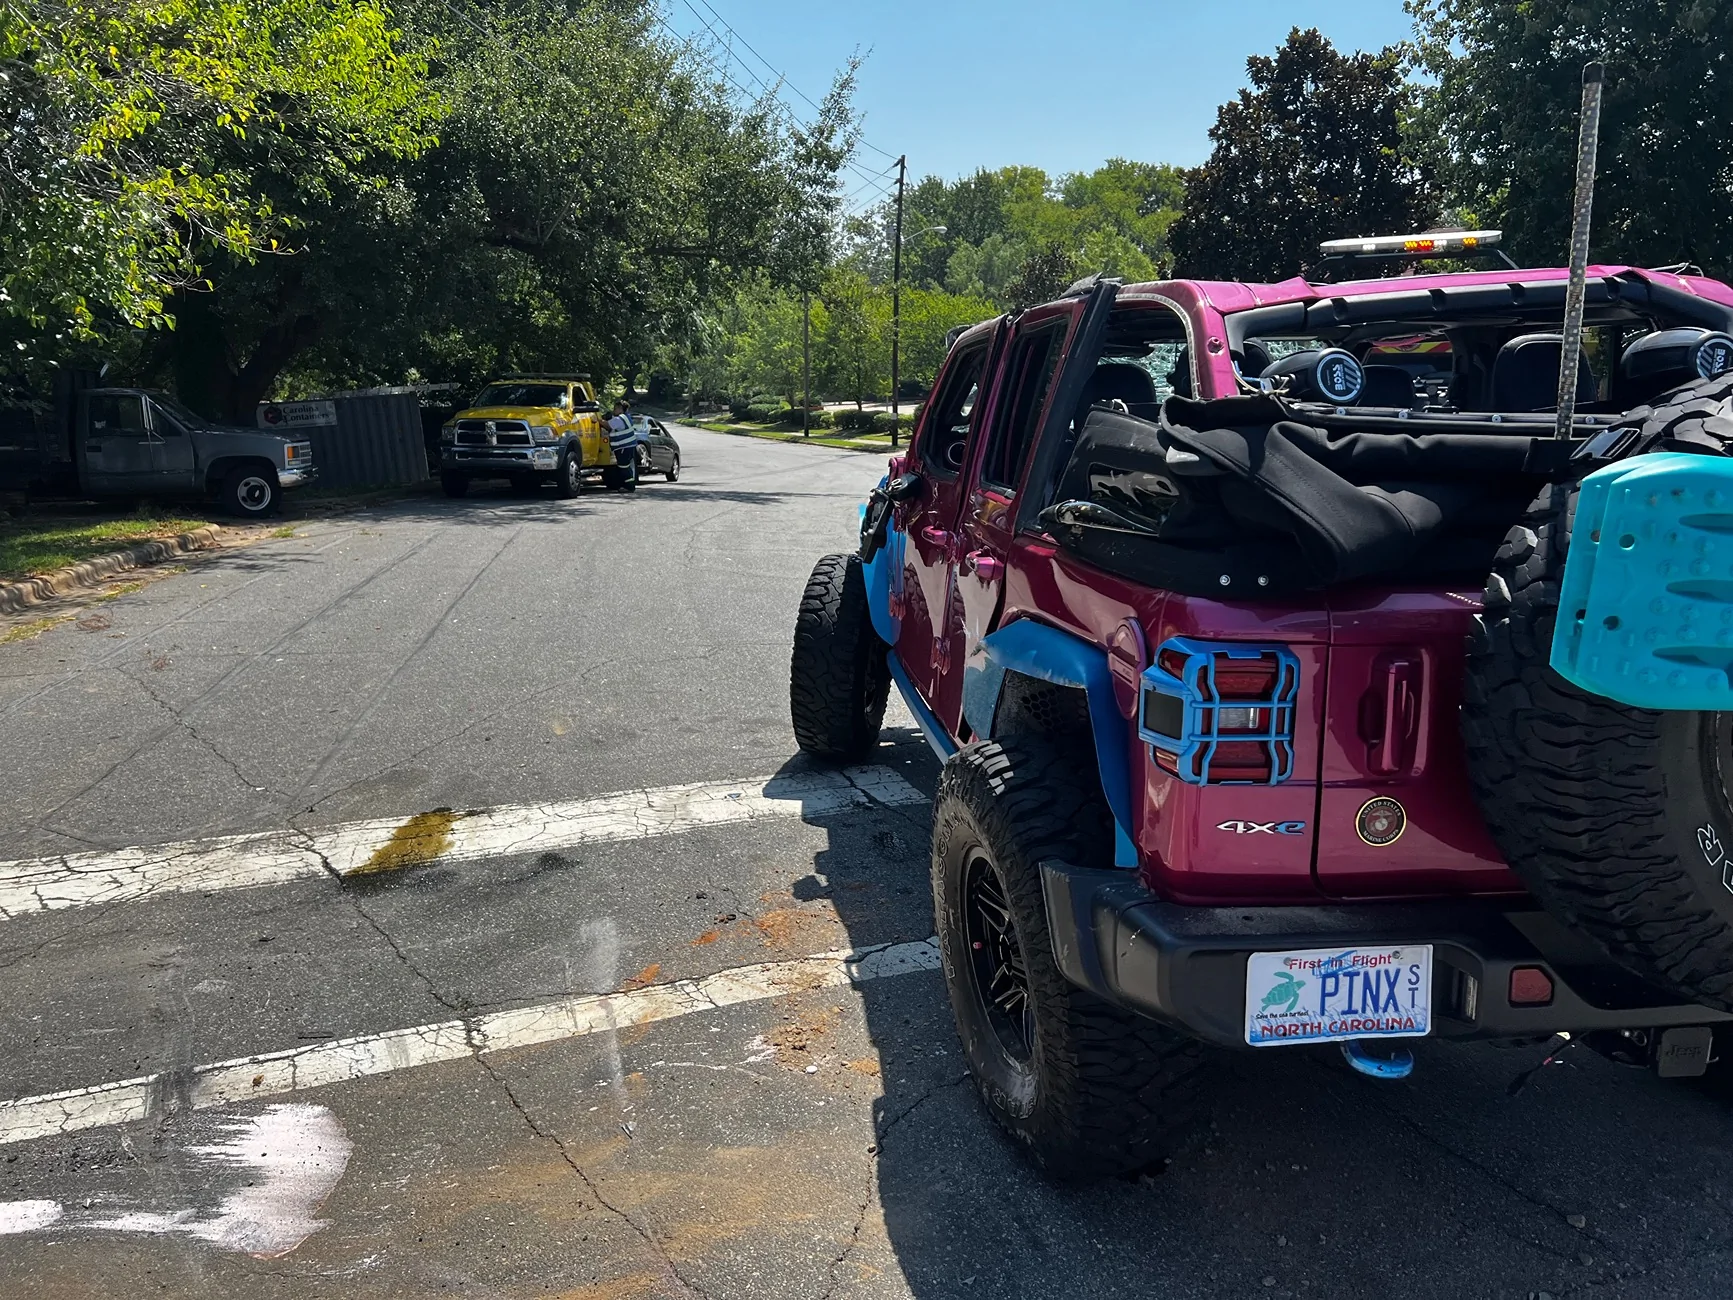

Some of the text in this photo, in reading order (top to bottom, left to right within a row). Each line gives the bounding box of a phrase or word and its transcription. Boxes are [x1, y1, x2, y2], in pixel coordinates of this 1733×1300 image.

[1332, 363, 1343, 391] BOSS
[283, 404, 318, 414] Carolina
[283, 412, 329, 424] Containers
[1361, 801, 1401, 818] UNITED STATES
[1363, 829, 1399, 843] MARINE CORPS
[1289, 953, 1392, 970] First in Flight
[1320, 968, 1401, 1016] PINX
[1261, 1017, 1415, 1038] NORTH CAROLINA
[1664, 1044, 1702, 1058] Jeep
